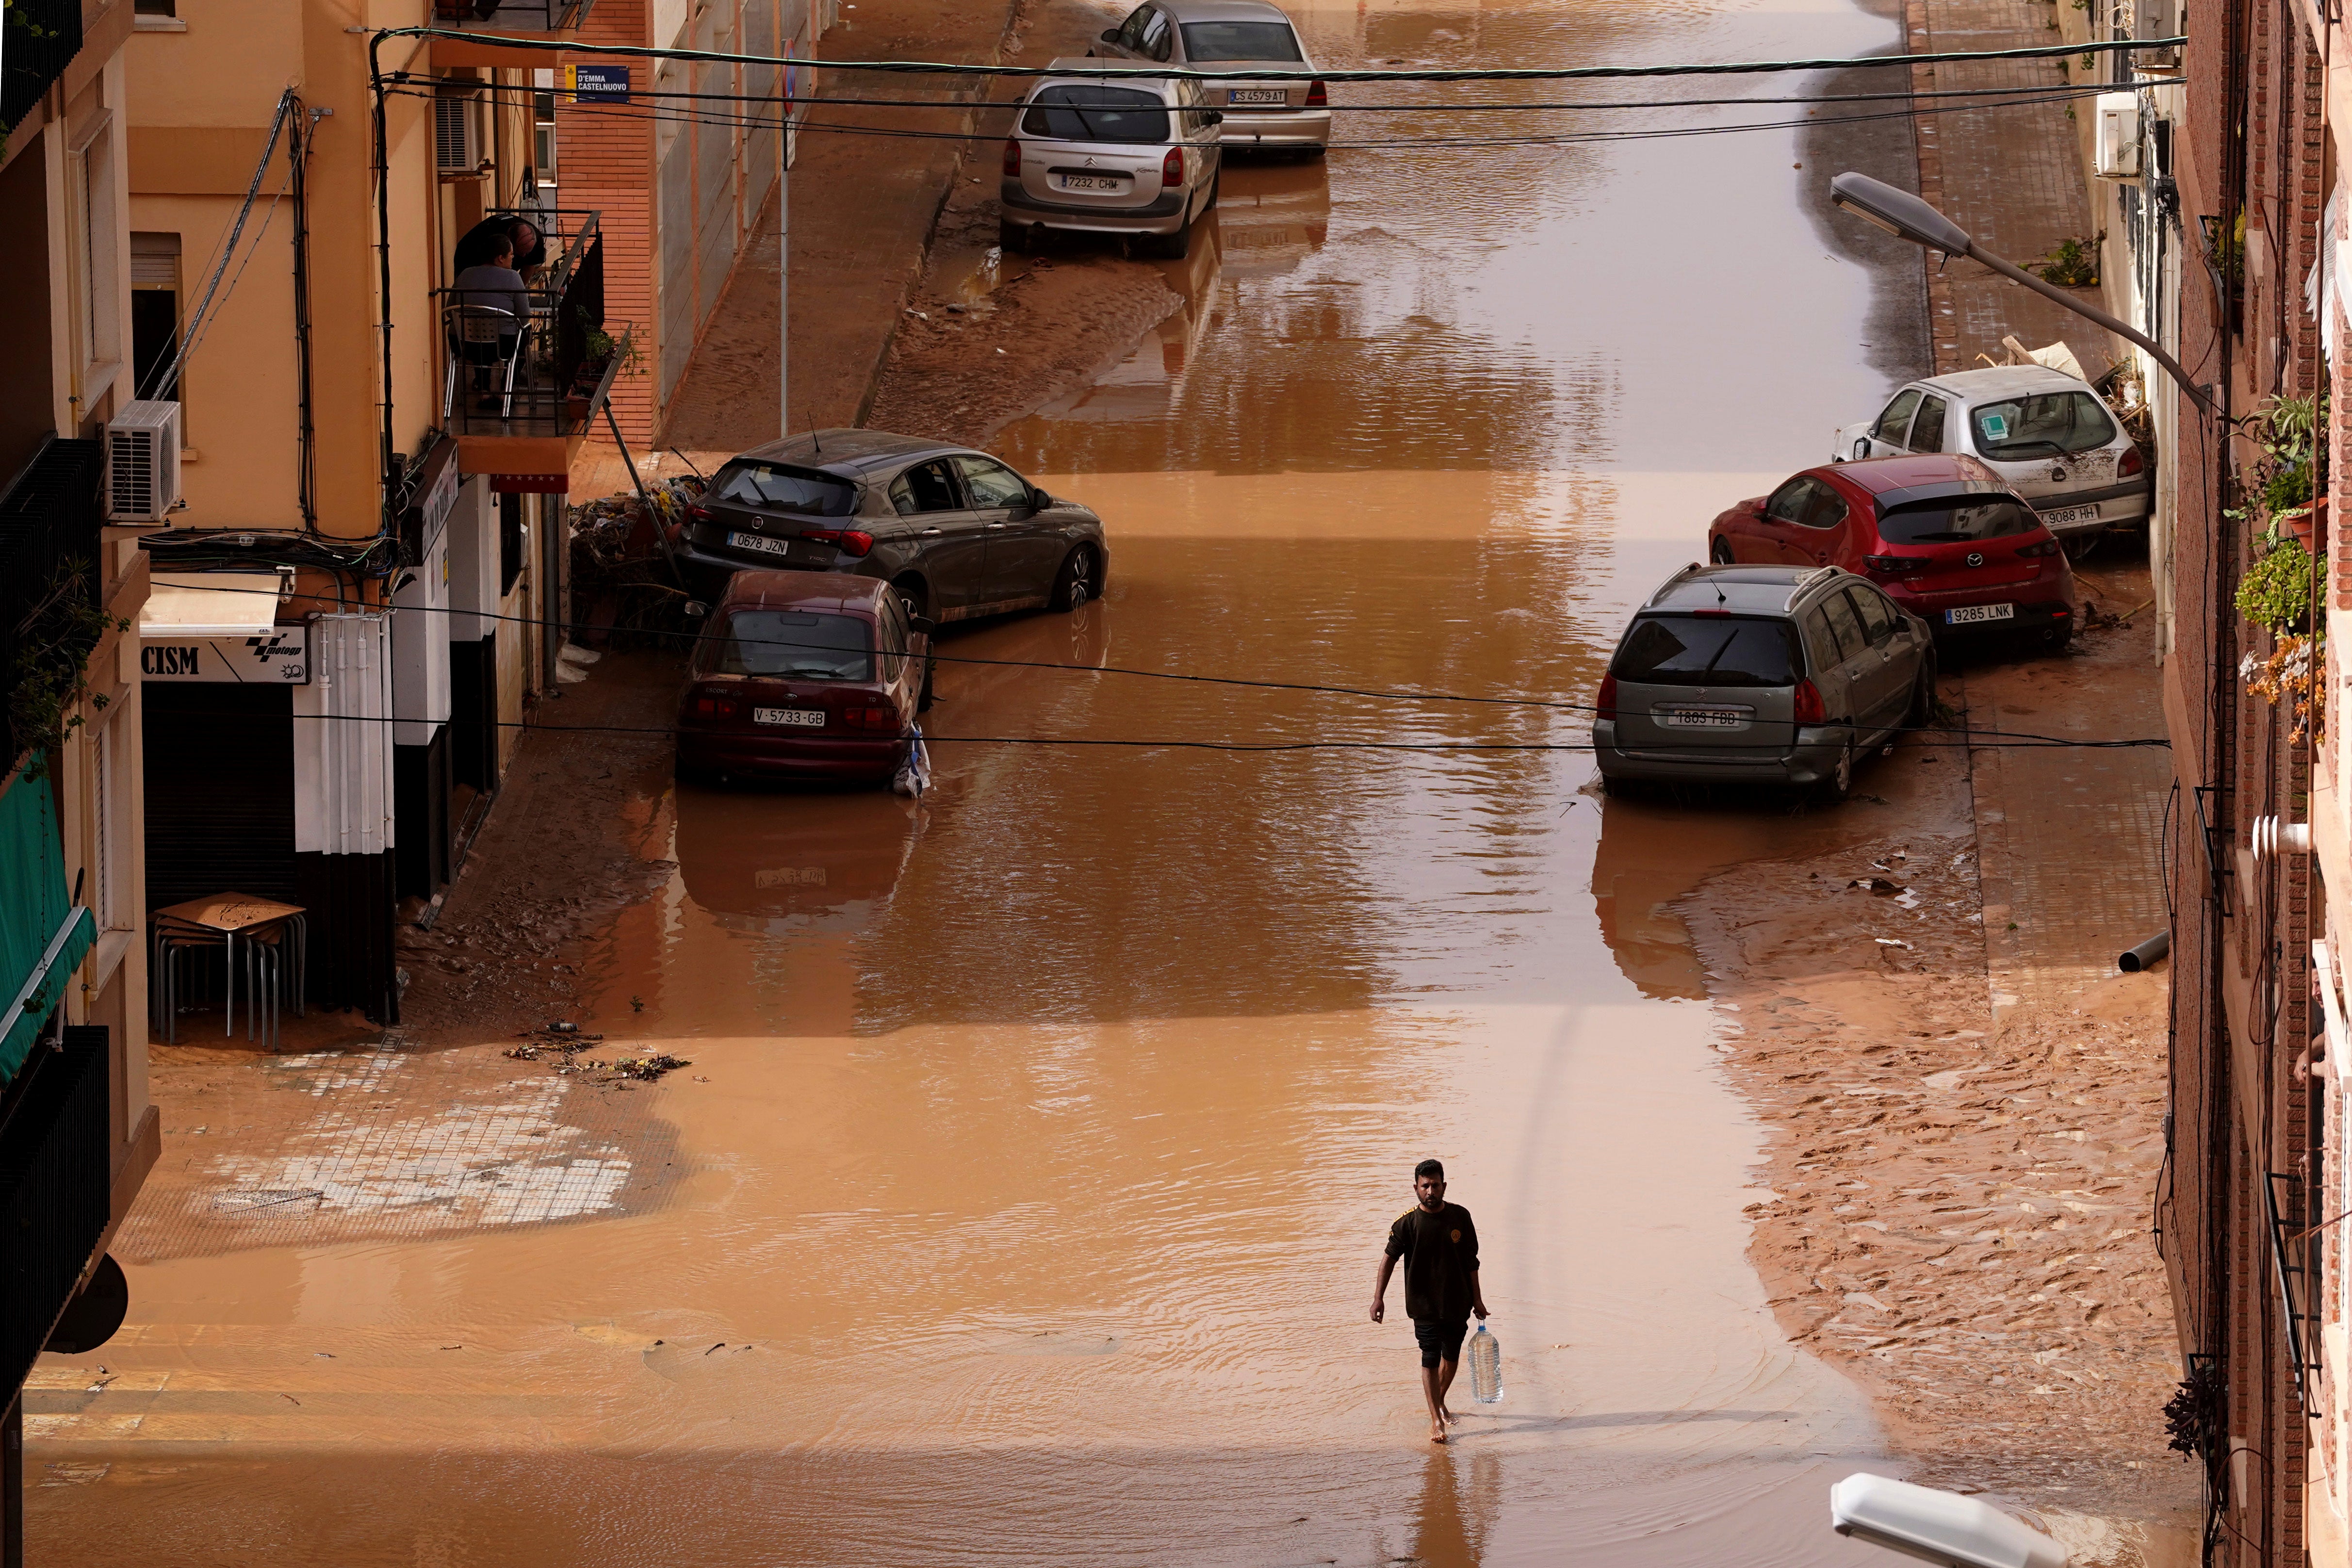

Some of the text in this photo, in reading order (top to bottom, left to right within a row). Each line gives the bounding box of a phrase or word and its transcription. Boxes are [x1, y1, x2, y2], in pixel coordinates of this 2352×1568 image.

[1234, 91, 1245, 100] CS
[1247, 92, 1271, 100] 4579
[1273, 92, 1283, 100] AT
[1069, 177, 1117, 189] 7232 CHM
[2049, 510, 2075, 523] 9088
[2080, 507, 2093, 519] HH
[738, 535, 762, 548] 0678
[766, 540, 785, 553] JZN
[1955, 605, 2010, 621] 9285 LNK
[266, 646, 302, 655] motogp
[141, 646, 199, 675] CISM
